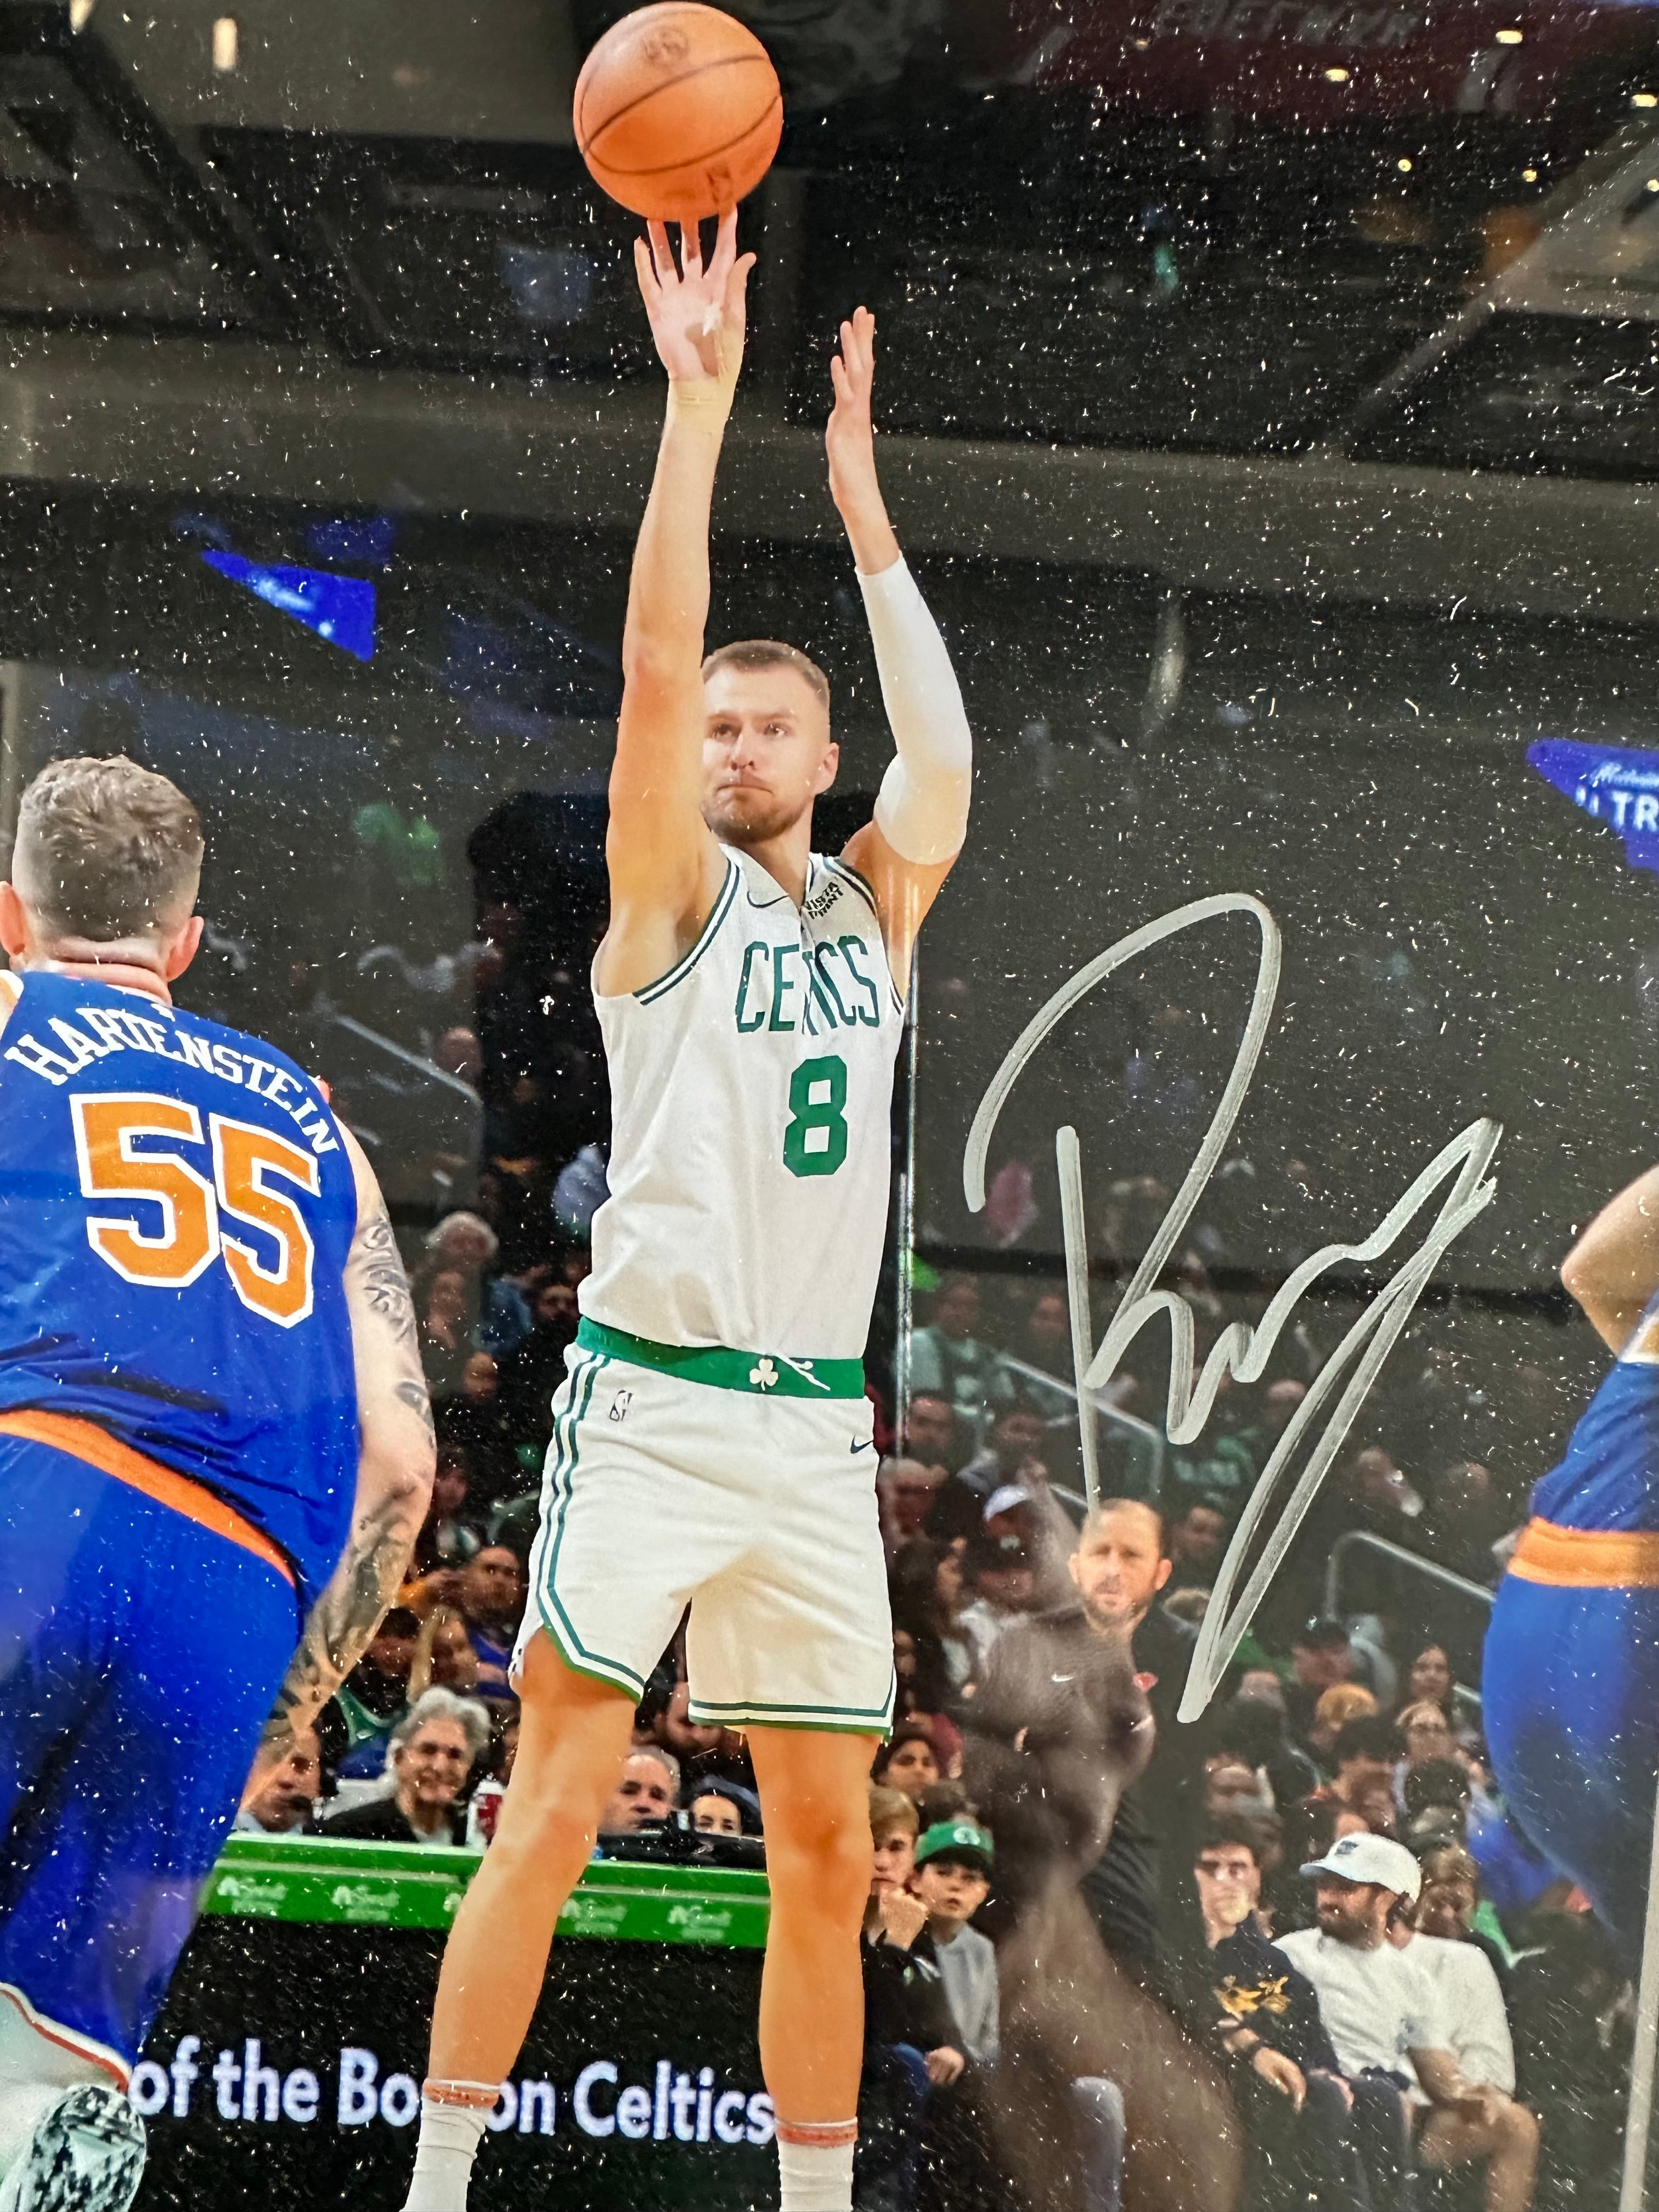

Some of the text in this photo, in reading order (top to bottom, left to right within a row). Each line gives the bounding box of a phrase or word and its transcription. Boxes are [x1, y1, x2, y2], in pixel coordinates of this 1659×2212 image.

[735, 935, 880, 1036] CEICS
[4, 1007, 340, 1154] HARTENSTEIN
[783, 1055, 848, 1177] 8
[69, 1092, 321, 1328] 55
[128, 2035, 777, 2145] of the Boon Celtics
